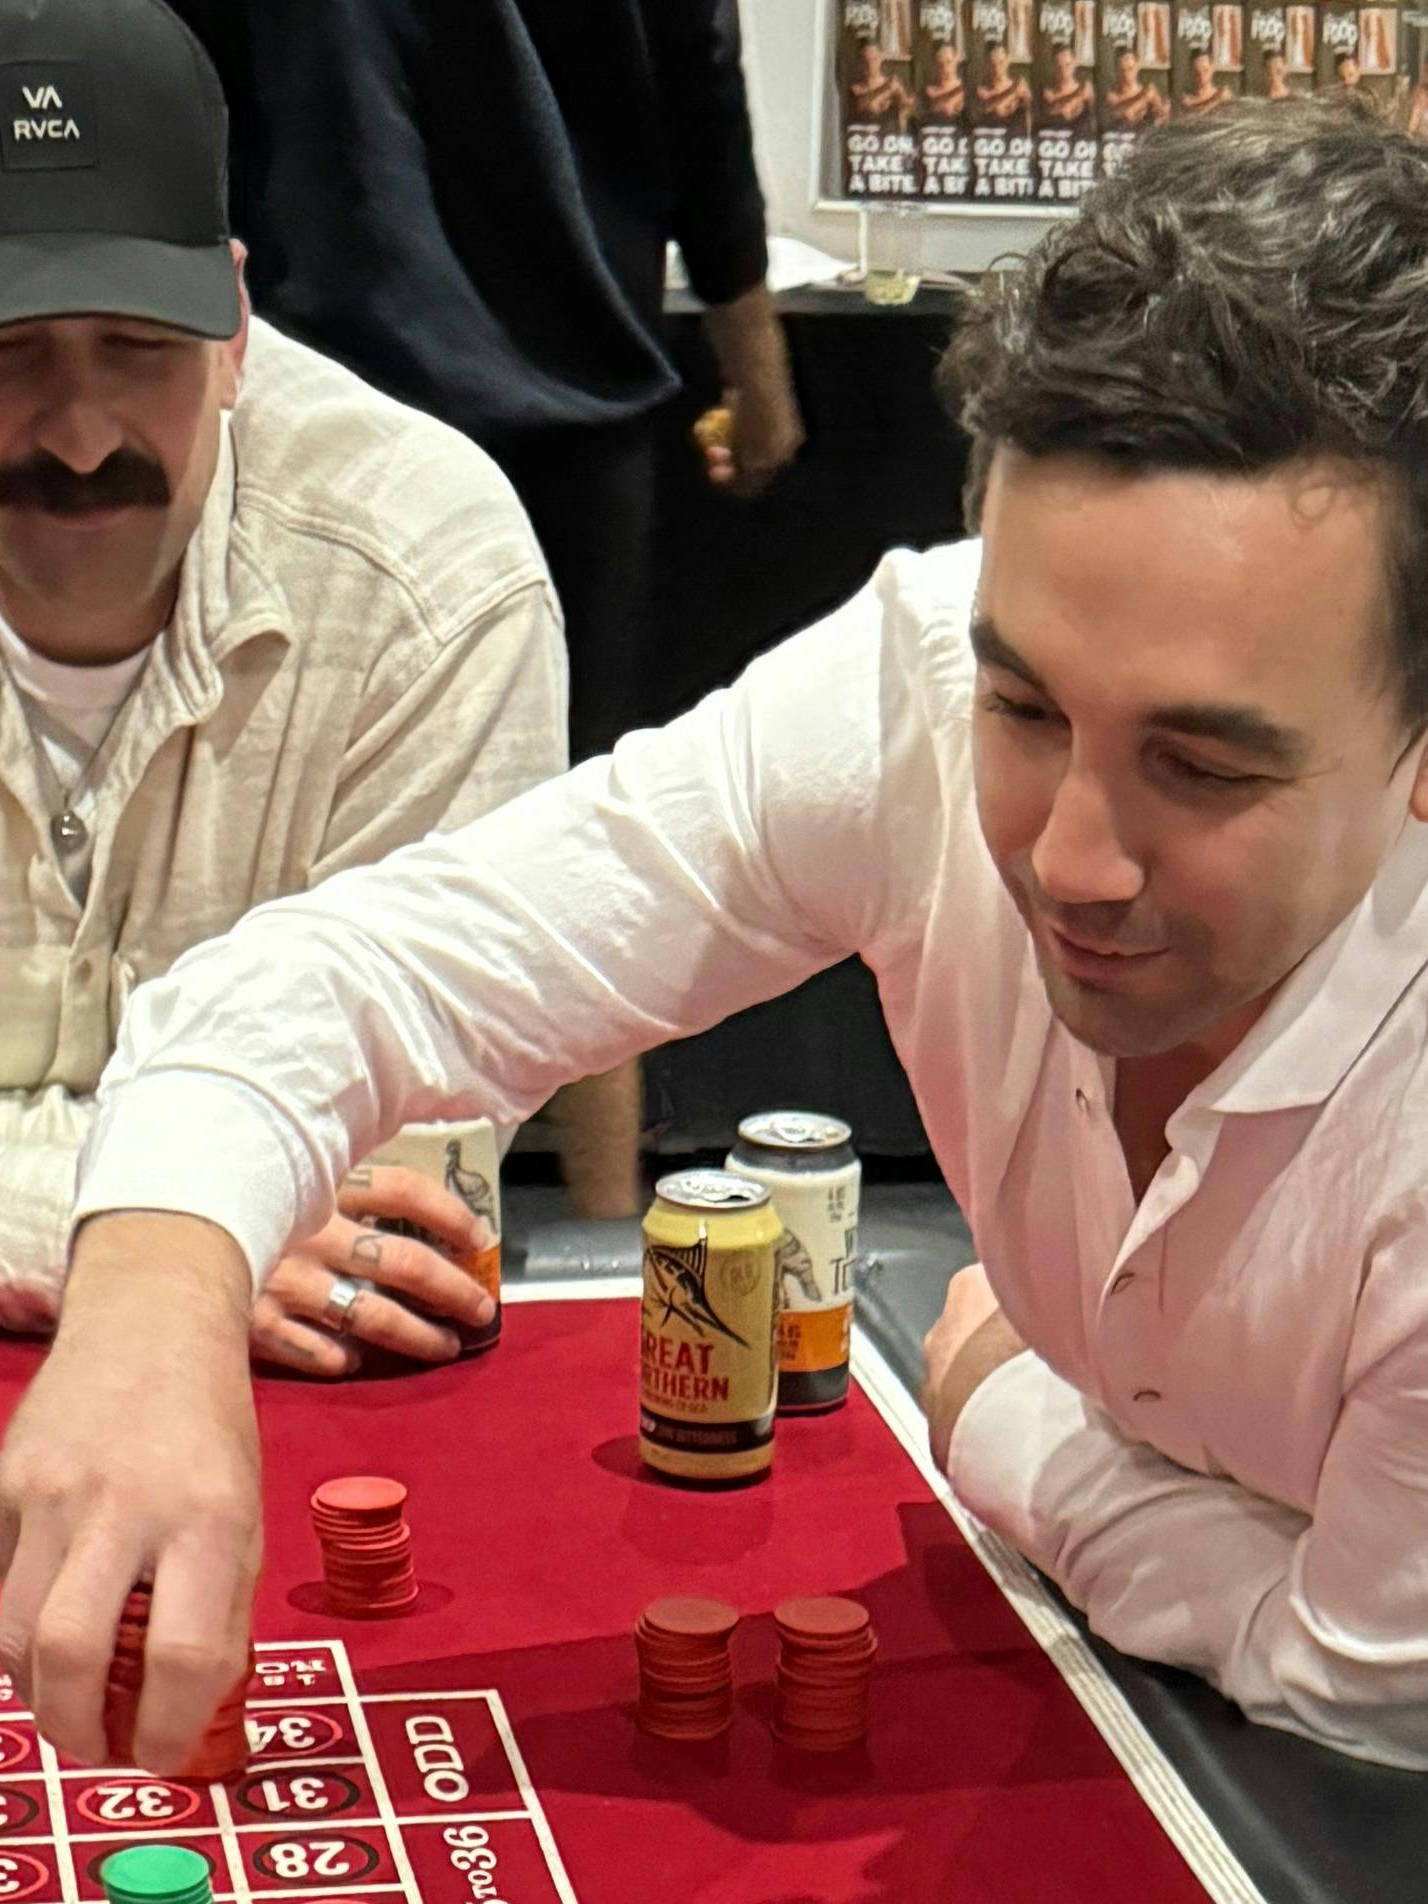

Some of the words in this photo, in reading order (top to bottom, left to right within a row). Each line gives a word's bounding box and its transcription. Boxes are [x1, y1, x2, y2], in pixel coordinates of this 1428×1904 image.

[22, 85, 63, 109] VA
[13, 119, 80, 140] RVCA
[922, 156, 968, 175] TAK
[643, 1362, 729, 1401] RTHERN
[244, 1717, 315, 1753] 34
[405, 1715, 469, 1802] ODD
[95, 1785, 174, 1820] 32
[259, 1773, 324, 1811] 31
[269, 1841, 350, 1878] 28
